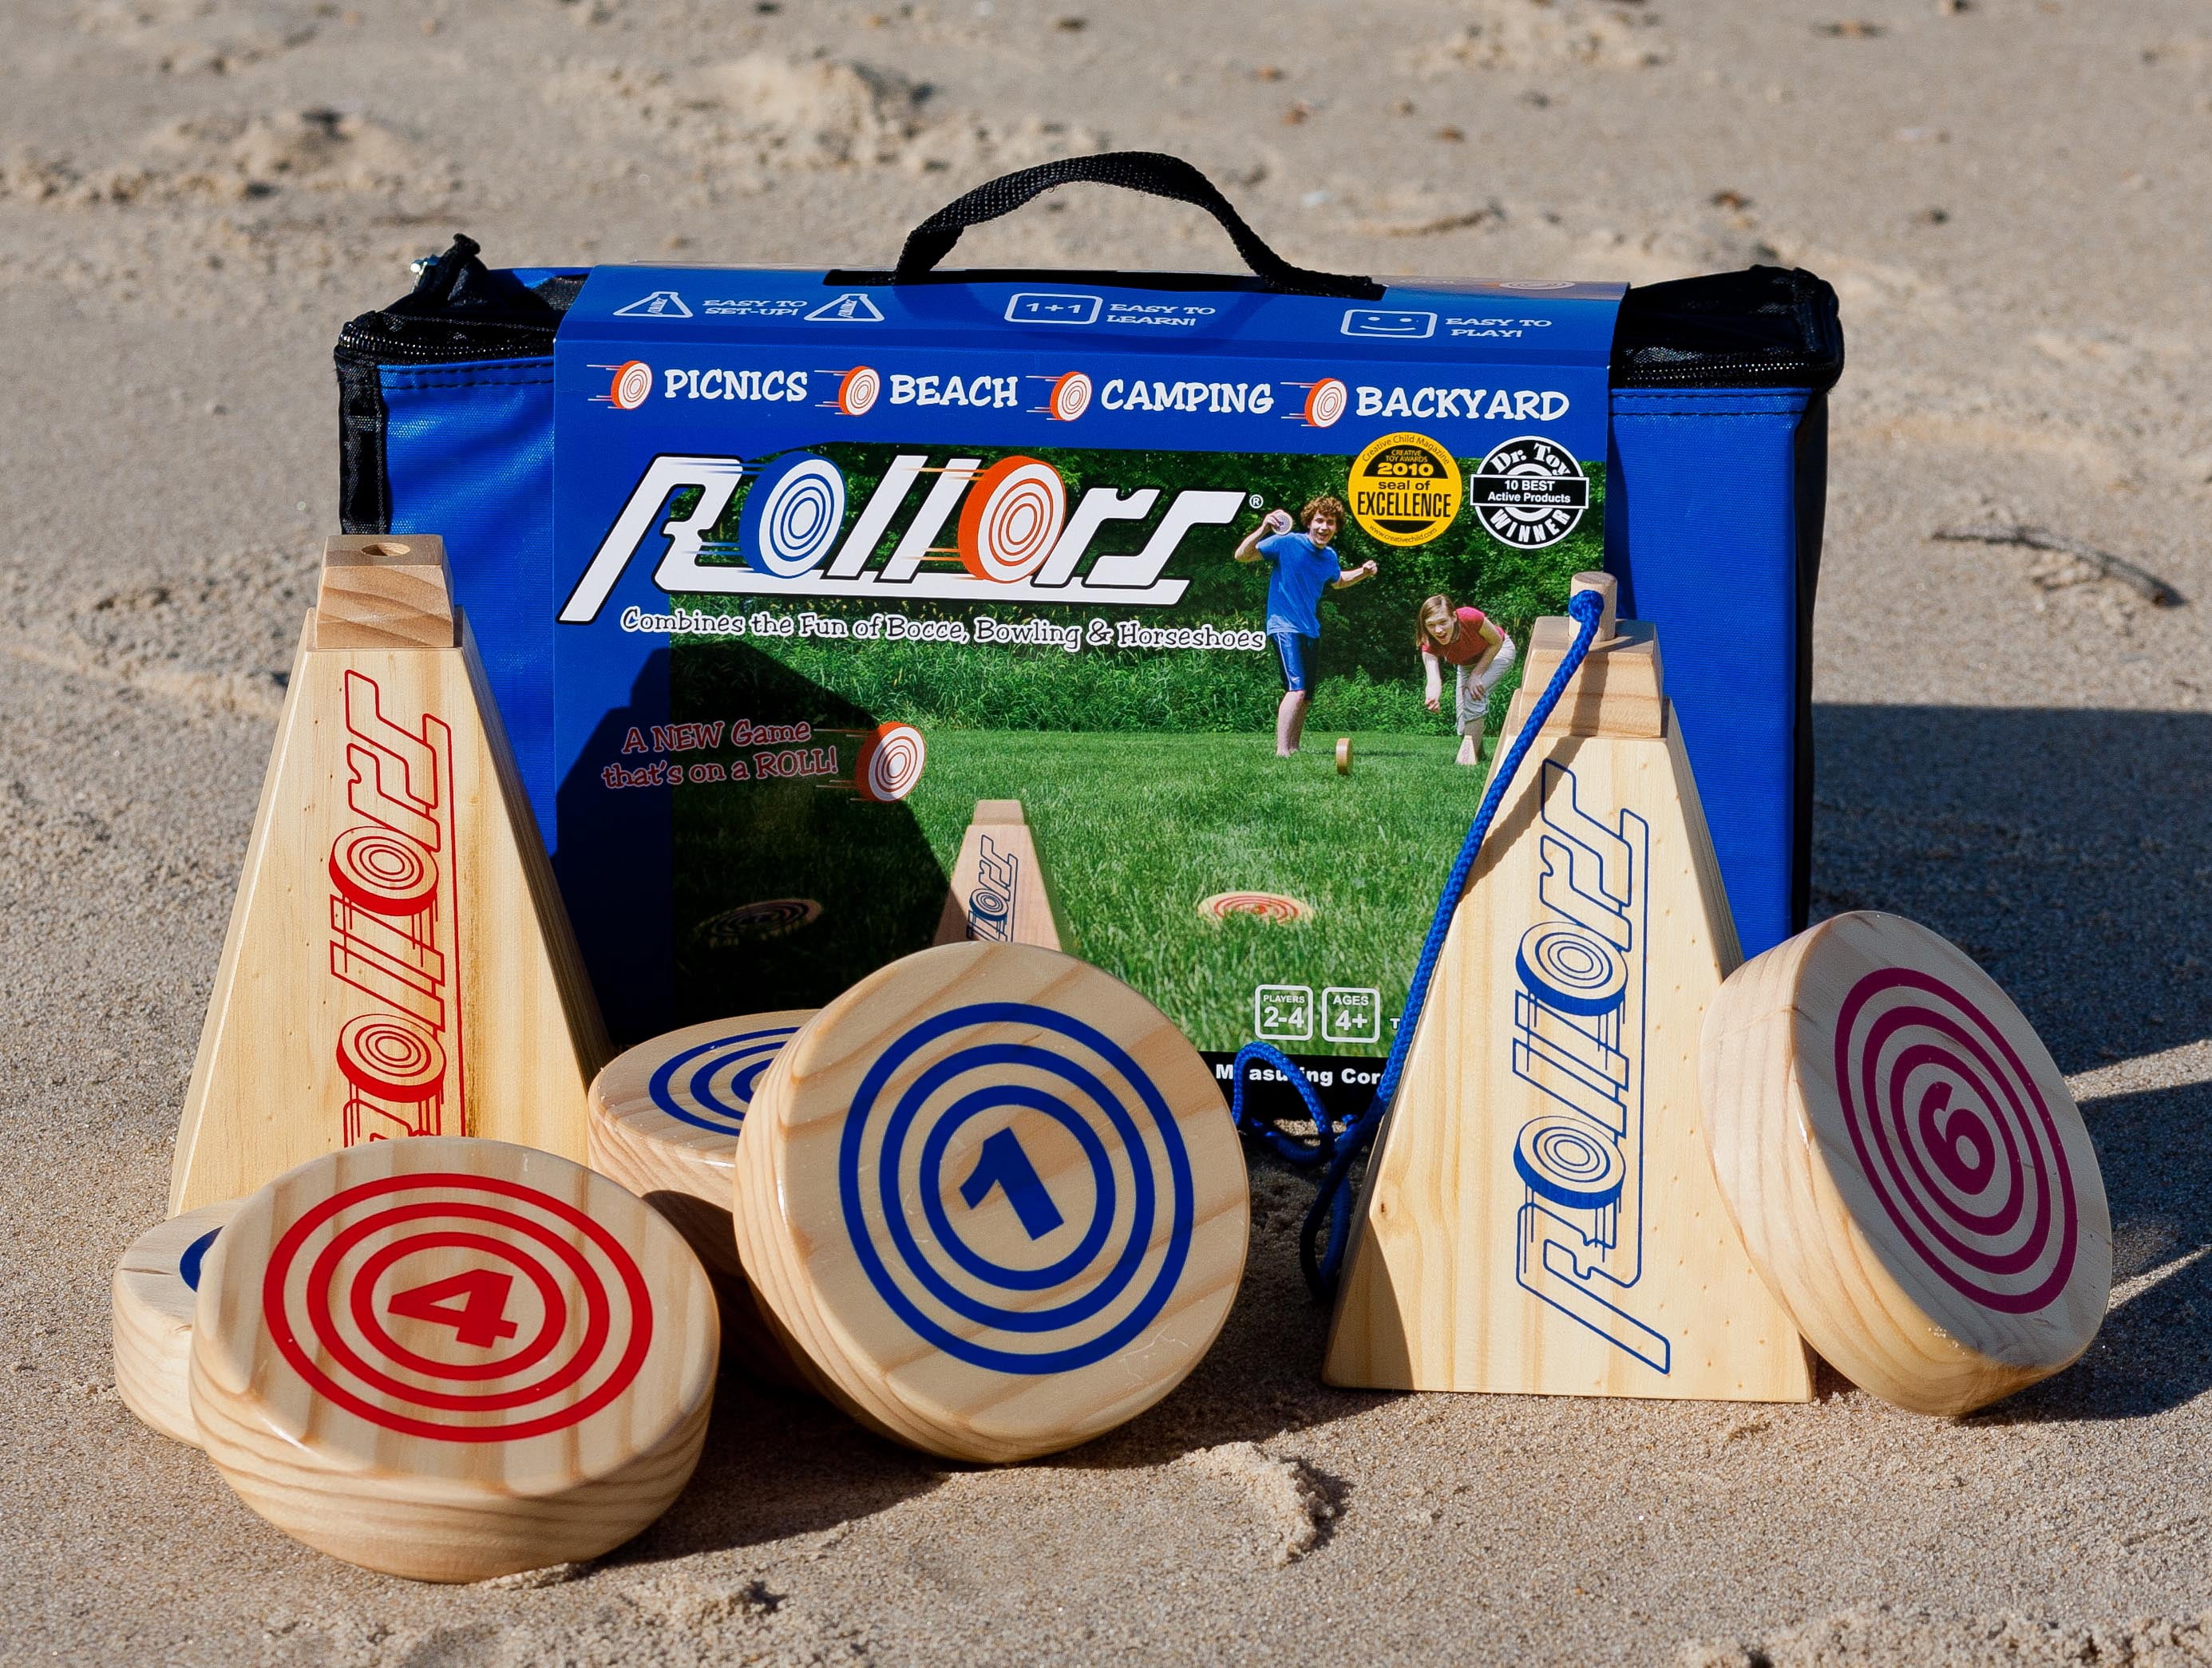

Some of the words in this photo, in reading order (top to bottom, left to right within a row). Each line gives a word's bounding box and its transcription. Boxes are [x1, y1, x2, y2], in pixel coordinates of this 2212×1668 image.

[704, 307, 798, 316] SET-UP!
[1026, 302, 1082, 314] 1+1
[1109, 303, 1179, 314] EASY
[1183, 306, 1216, 315] TO
[1106, 315, 1196, 326] LEARN!
[1445, 318, 1514, 326] EASY
[1450, 329, 1523, 338] PLAY!
[663, 369, 808, 402] PICNICS
[890, 374, 1018, 408] BEACH
[1101, 378, 1274, 414] CAMPING
[1356, 386, 1569, 421] BACKYARD
[1362, 439, 1391, 462] Creative
[1416, 437, 1450, 464] Magazine
[1490, 449, 1526, 473] Dr.
[1533, 443, 1571, 475] Toy
[1377, 463, 1434, 476] 2010
[1379, 480, 1411, 490] seal
[1415, 480, 1430, 490] of
[1505, 480, 1518, 491] 10
[1521, 480, 1555, 491] BEST
[1358, 491, 1451, 518] EXCELLENCE
[1488, 492, 1521, 501] Active
[1523, 492, 1571, 503] Products
[1369, 524, 1437, 543] www.creativechild.com
[1490, 508, 1571, 543] WINNER
[620, 606, 744, 634] Combines
[751, 613, 793, 634] the
[799, 612, 847, 638] Fun
[855, 613, 884, 638] of
[884, 615, 970, 644] Bocce,
[975, 617, 1082, 652] Bowling
[1086, 618, 1114, 646] &
[1118, 621, 1266, 651] Horseshoes
[622, 727, 648, 753] A
[651, 721, 724, 752] NEW
[731, 719, 811, 746] Game
[602, 760, 683, 788] that's
[690, 762, 726, 783] on
[731, 761, 749, 781] a
[754, 745, 837, 779] ROLL!
[1264, 994, 1305, 1003] PLAYERS
[1333, 995, 1369, 1006] AGES
[1264, 1007, 1304, 1028] 2-4
[1335, 1010, 1367, 1030] 4+
[1341, 1068, 1386, 1085] Cor
[960, 1126, 1065, 1241] 1
[387, 1268, 519, 1349] 4
